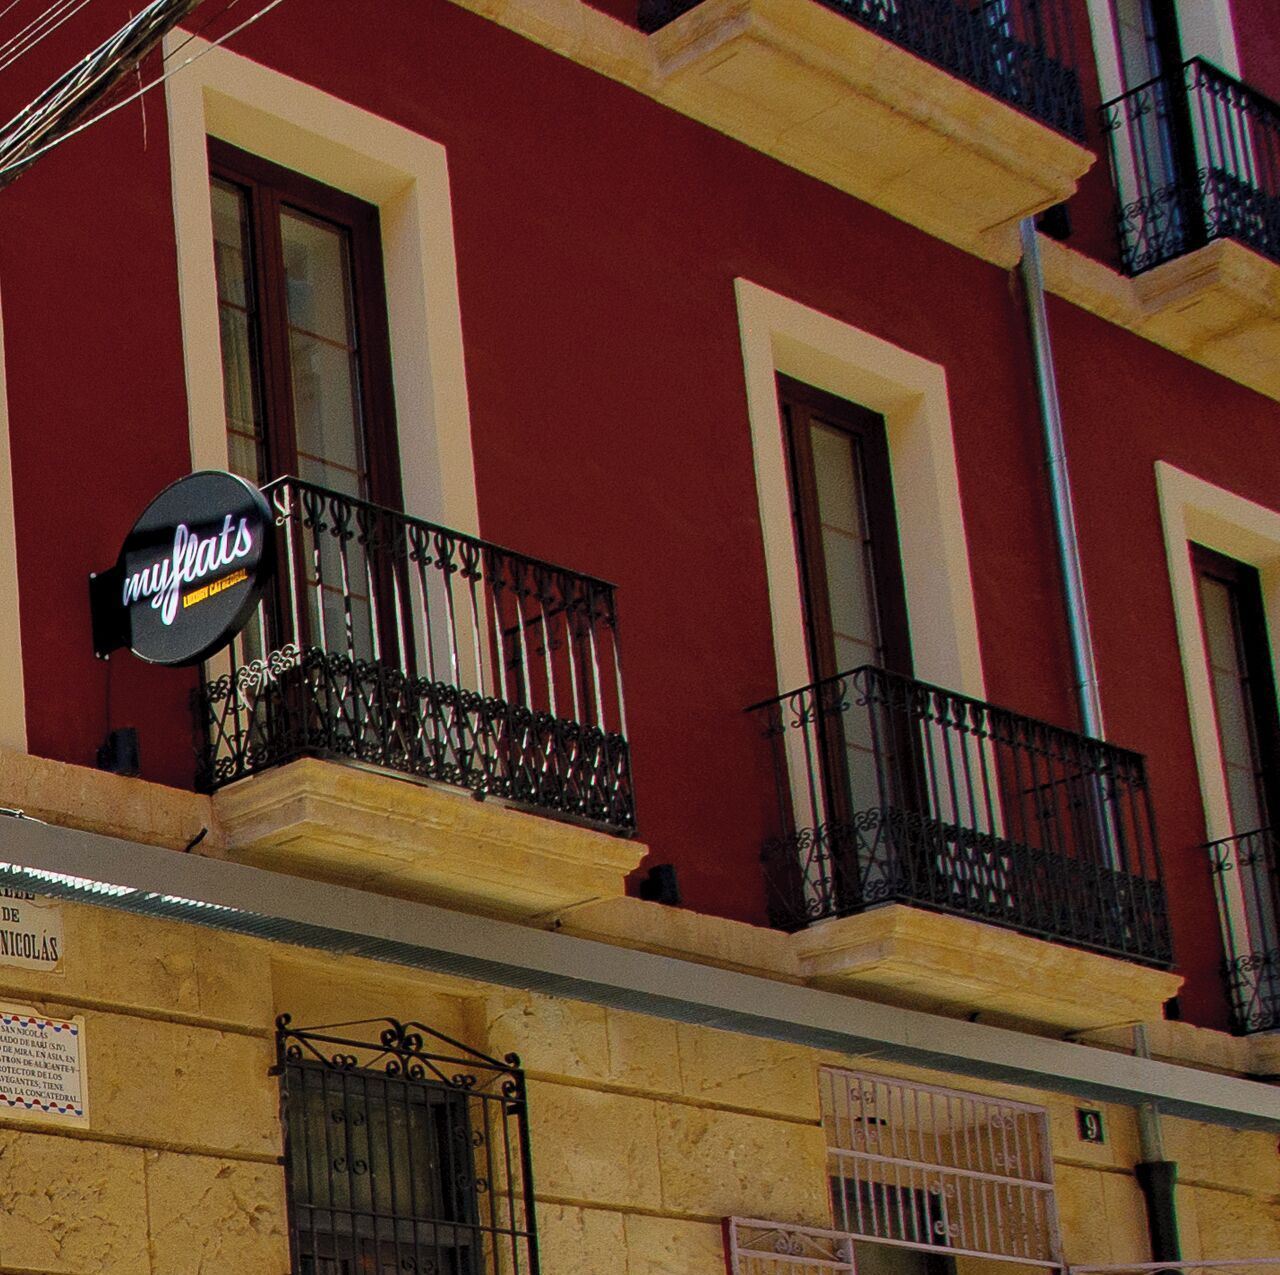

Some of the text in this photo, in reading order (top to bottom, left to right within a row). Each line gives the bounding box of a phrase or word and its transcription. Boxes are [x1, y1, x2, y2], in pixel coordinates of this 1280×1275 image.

[122, 513, 252, 626] myflats
[1, 906, 20, 923] DE
[0, 928, 59, 962] NICOLÁS
[0, 1025, 16, 1034] SAN
[20, 1038, 30, 1047] DE
[31, 1040, 47, 1049] BARI
[2, 1045, 13, 1054] DE
[35, 1050, 46, 1059] EN
[65, 1055, 76, 1064] EN
[23, 1059, 33, 1067] DE
[33, 1060, 69, 1073] ALICANTE
[37, 1070, 47, 1079] DE
[48, 1072, 63, 1081] LOS
[14, 1087, 24, 1096] LA
[42, 1081, 65, 1091] TIENE
[1086, 1113, 1097, 1139] 9
